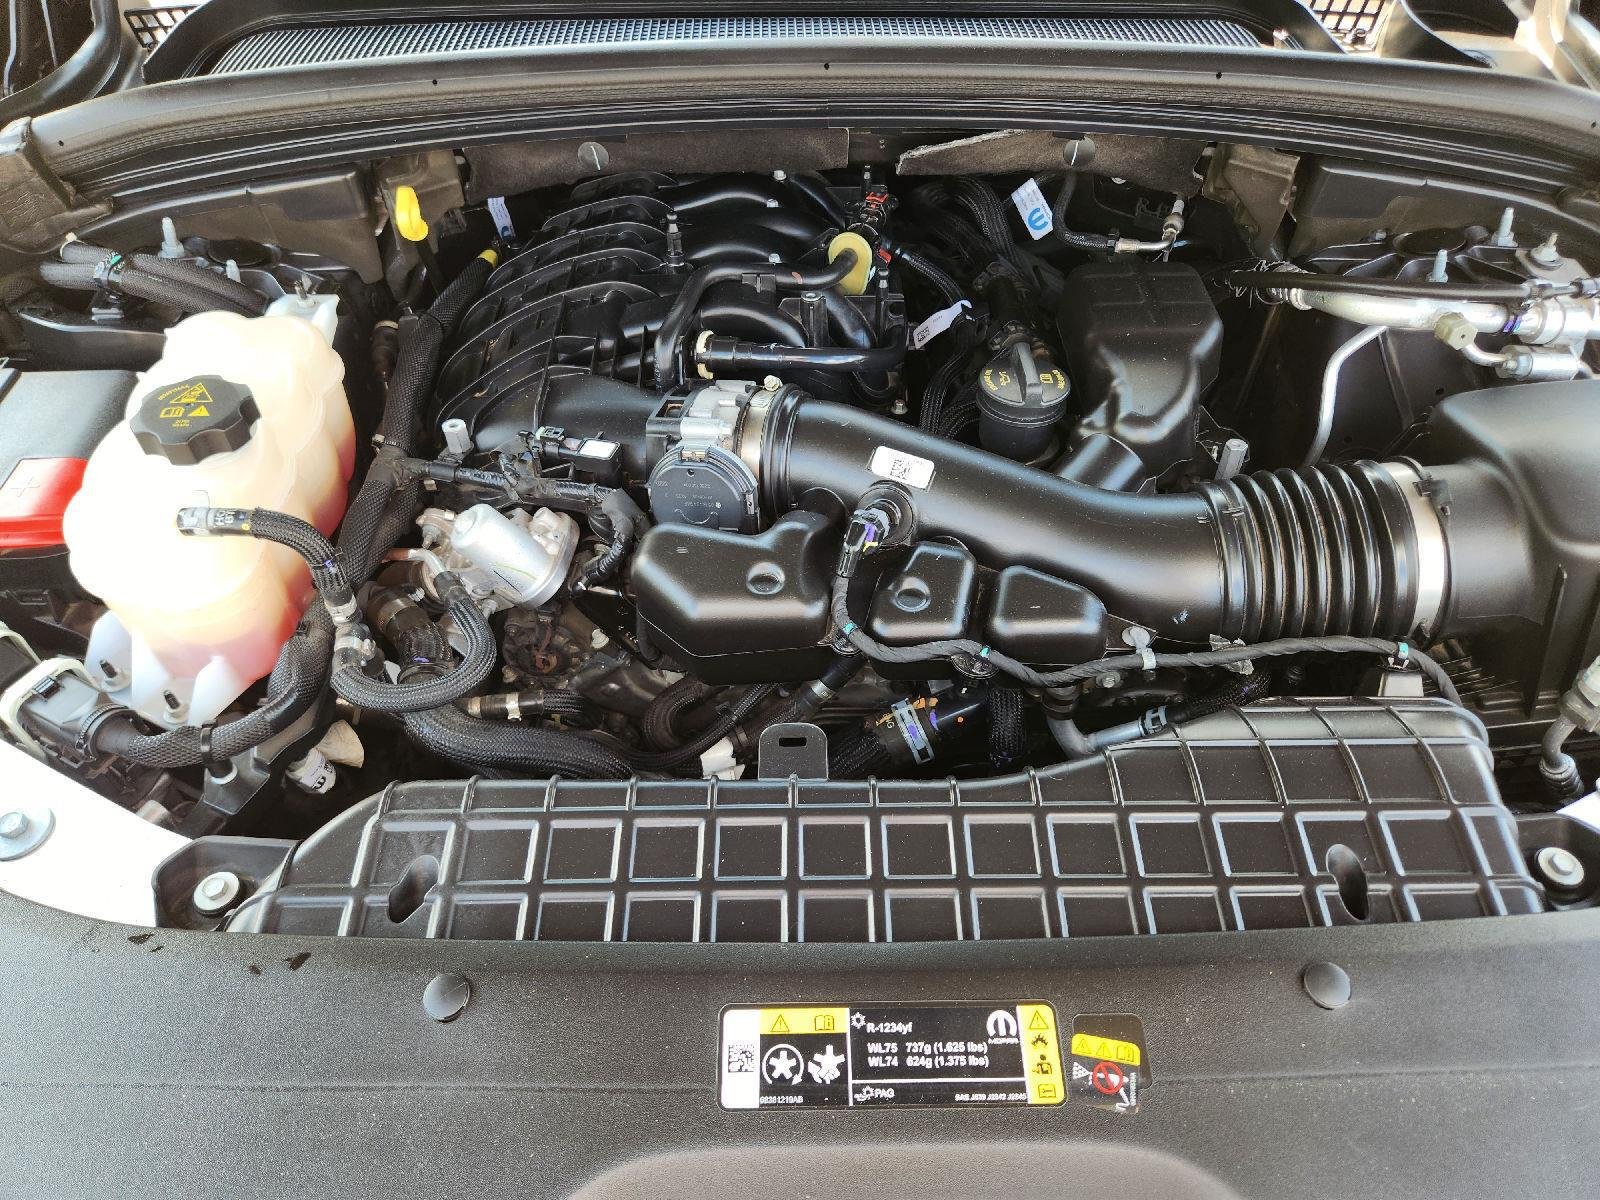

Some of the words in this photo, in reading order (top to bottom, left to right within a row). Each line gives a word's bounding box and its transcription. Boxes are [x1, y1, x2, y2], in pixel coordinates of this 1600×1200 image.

[866, 1022, 912, 1034] R-1234yf
[867, 1042, 898, 1053] WL75
[906, 1042, 931, 1054] 737g
[933, 1042, 965, 1053] (1.625
[967, 1041, 988, 1054] lbs)
[867, 1056, 898, 1067] WL74
[906, 1056, 933, 1068] 624g
[934, 1056, 966, 1068] (1.375
[968, 1055, 989, 1068] lbs)
[875, 1088, 895, 1098] PAG
